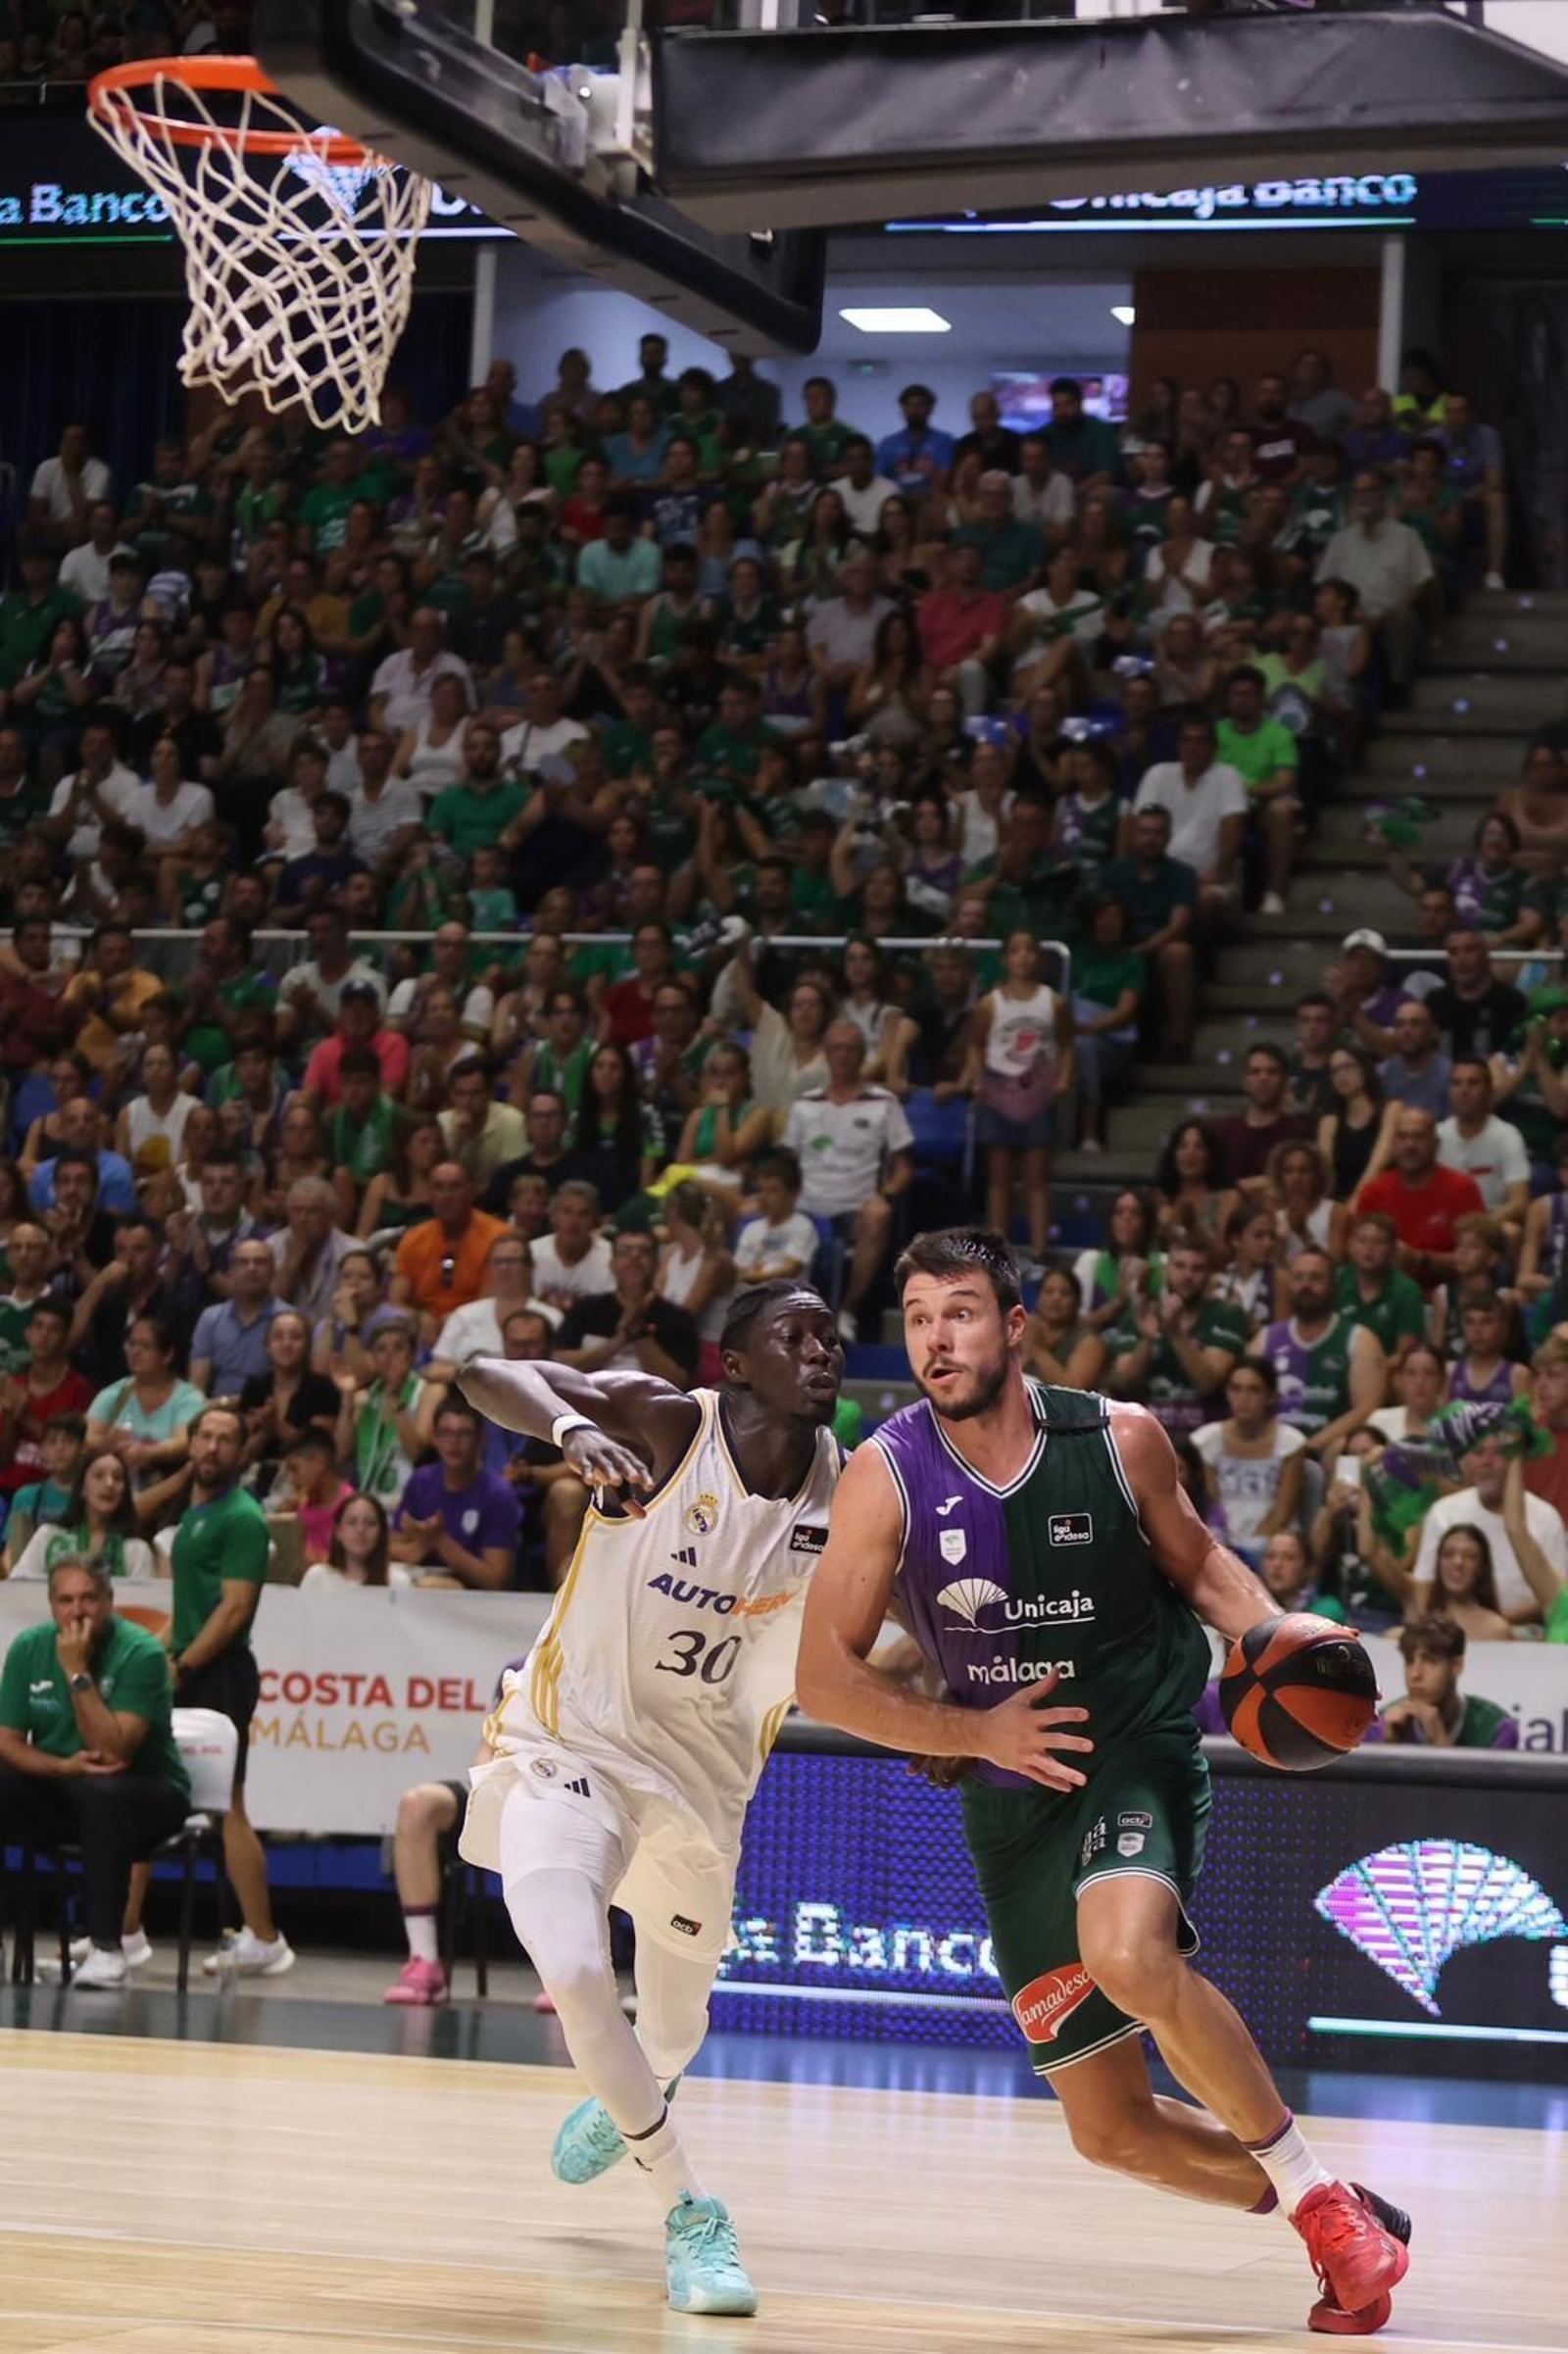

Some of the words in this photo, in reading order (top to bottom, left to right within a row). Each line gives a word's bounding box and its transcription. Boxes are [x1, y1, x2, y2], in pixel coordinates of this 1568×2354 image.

[29, 182, 172, 224] Banco
[1004, 1590, 1095, 1621] Unicaja
[654, 1630, 743, 1685] 30
[259, 1671, 395, 1707] COSTA
[407, 1676, 486, 1712] DEL
[251, 1709, 431, 1754] MÁLAGA
